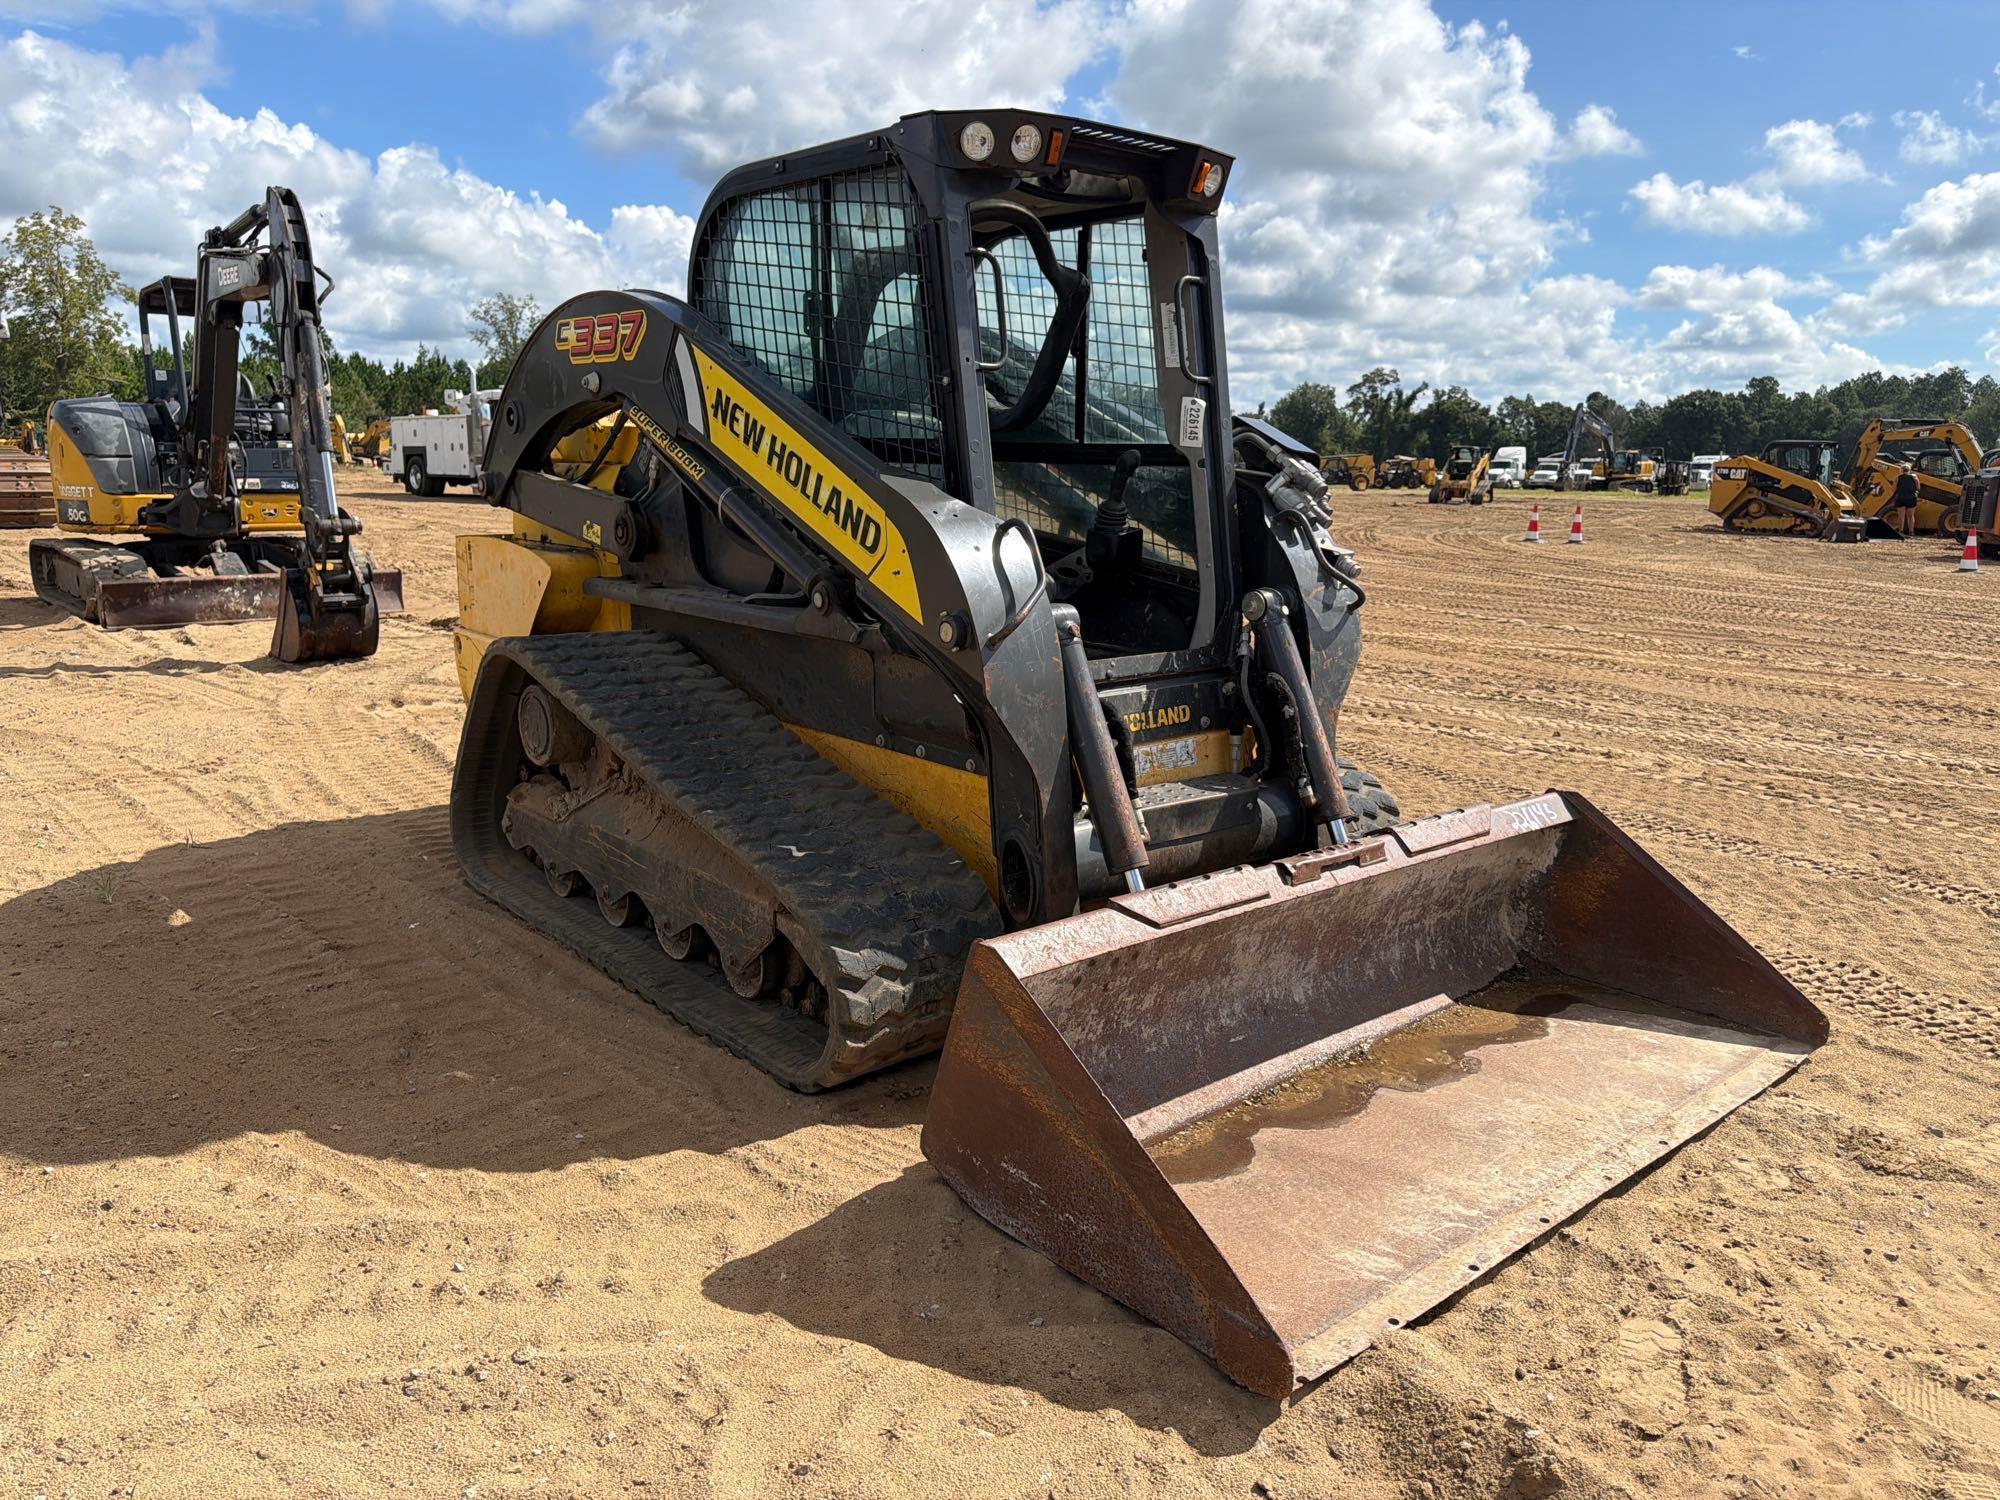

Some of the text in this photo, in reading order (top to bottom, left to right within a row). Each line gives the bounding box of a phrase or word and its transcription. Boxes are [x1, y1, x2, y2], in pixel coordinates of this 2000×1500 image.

[217, 266, 239, 287] DEERE
[1187, 407, 1201, 441] 226145
[629, 405, 706, 481] SUPER BOOM
[712, 386, 882, 555] NEW HOLLAND
[1730, 468, 1747, 480] CAT
[68, 508, 87, 522] 50G
